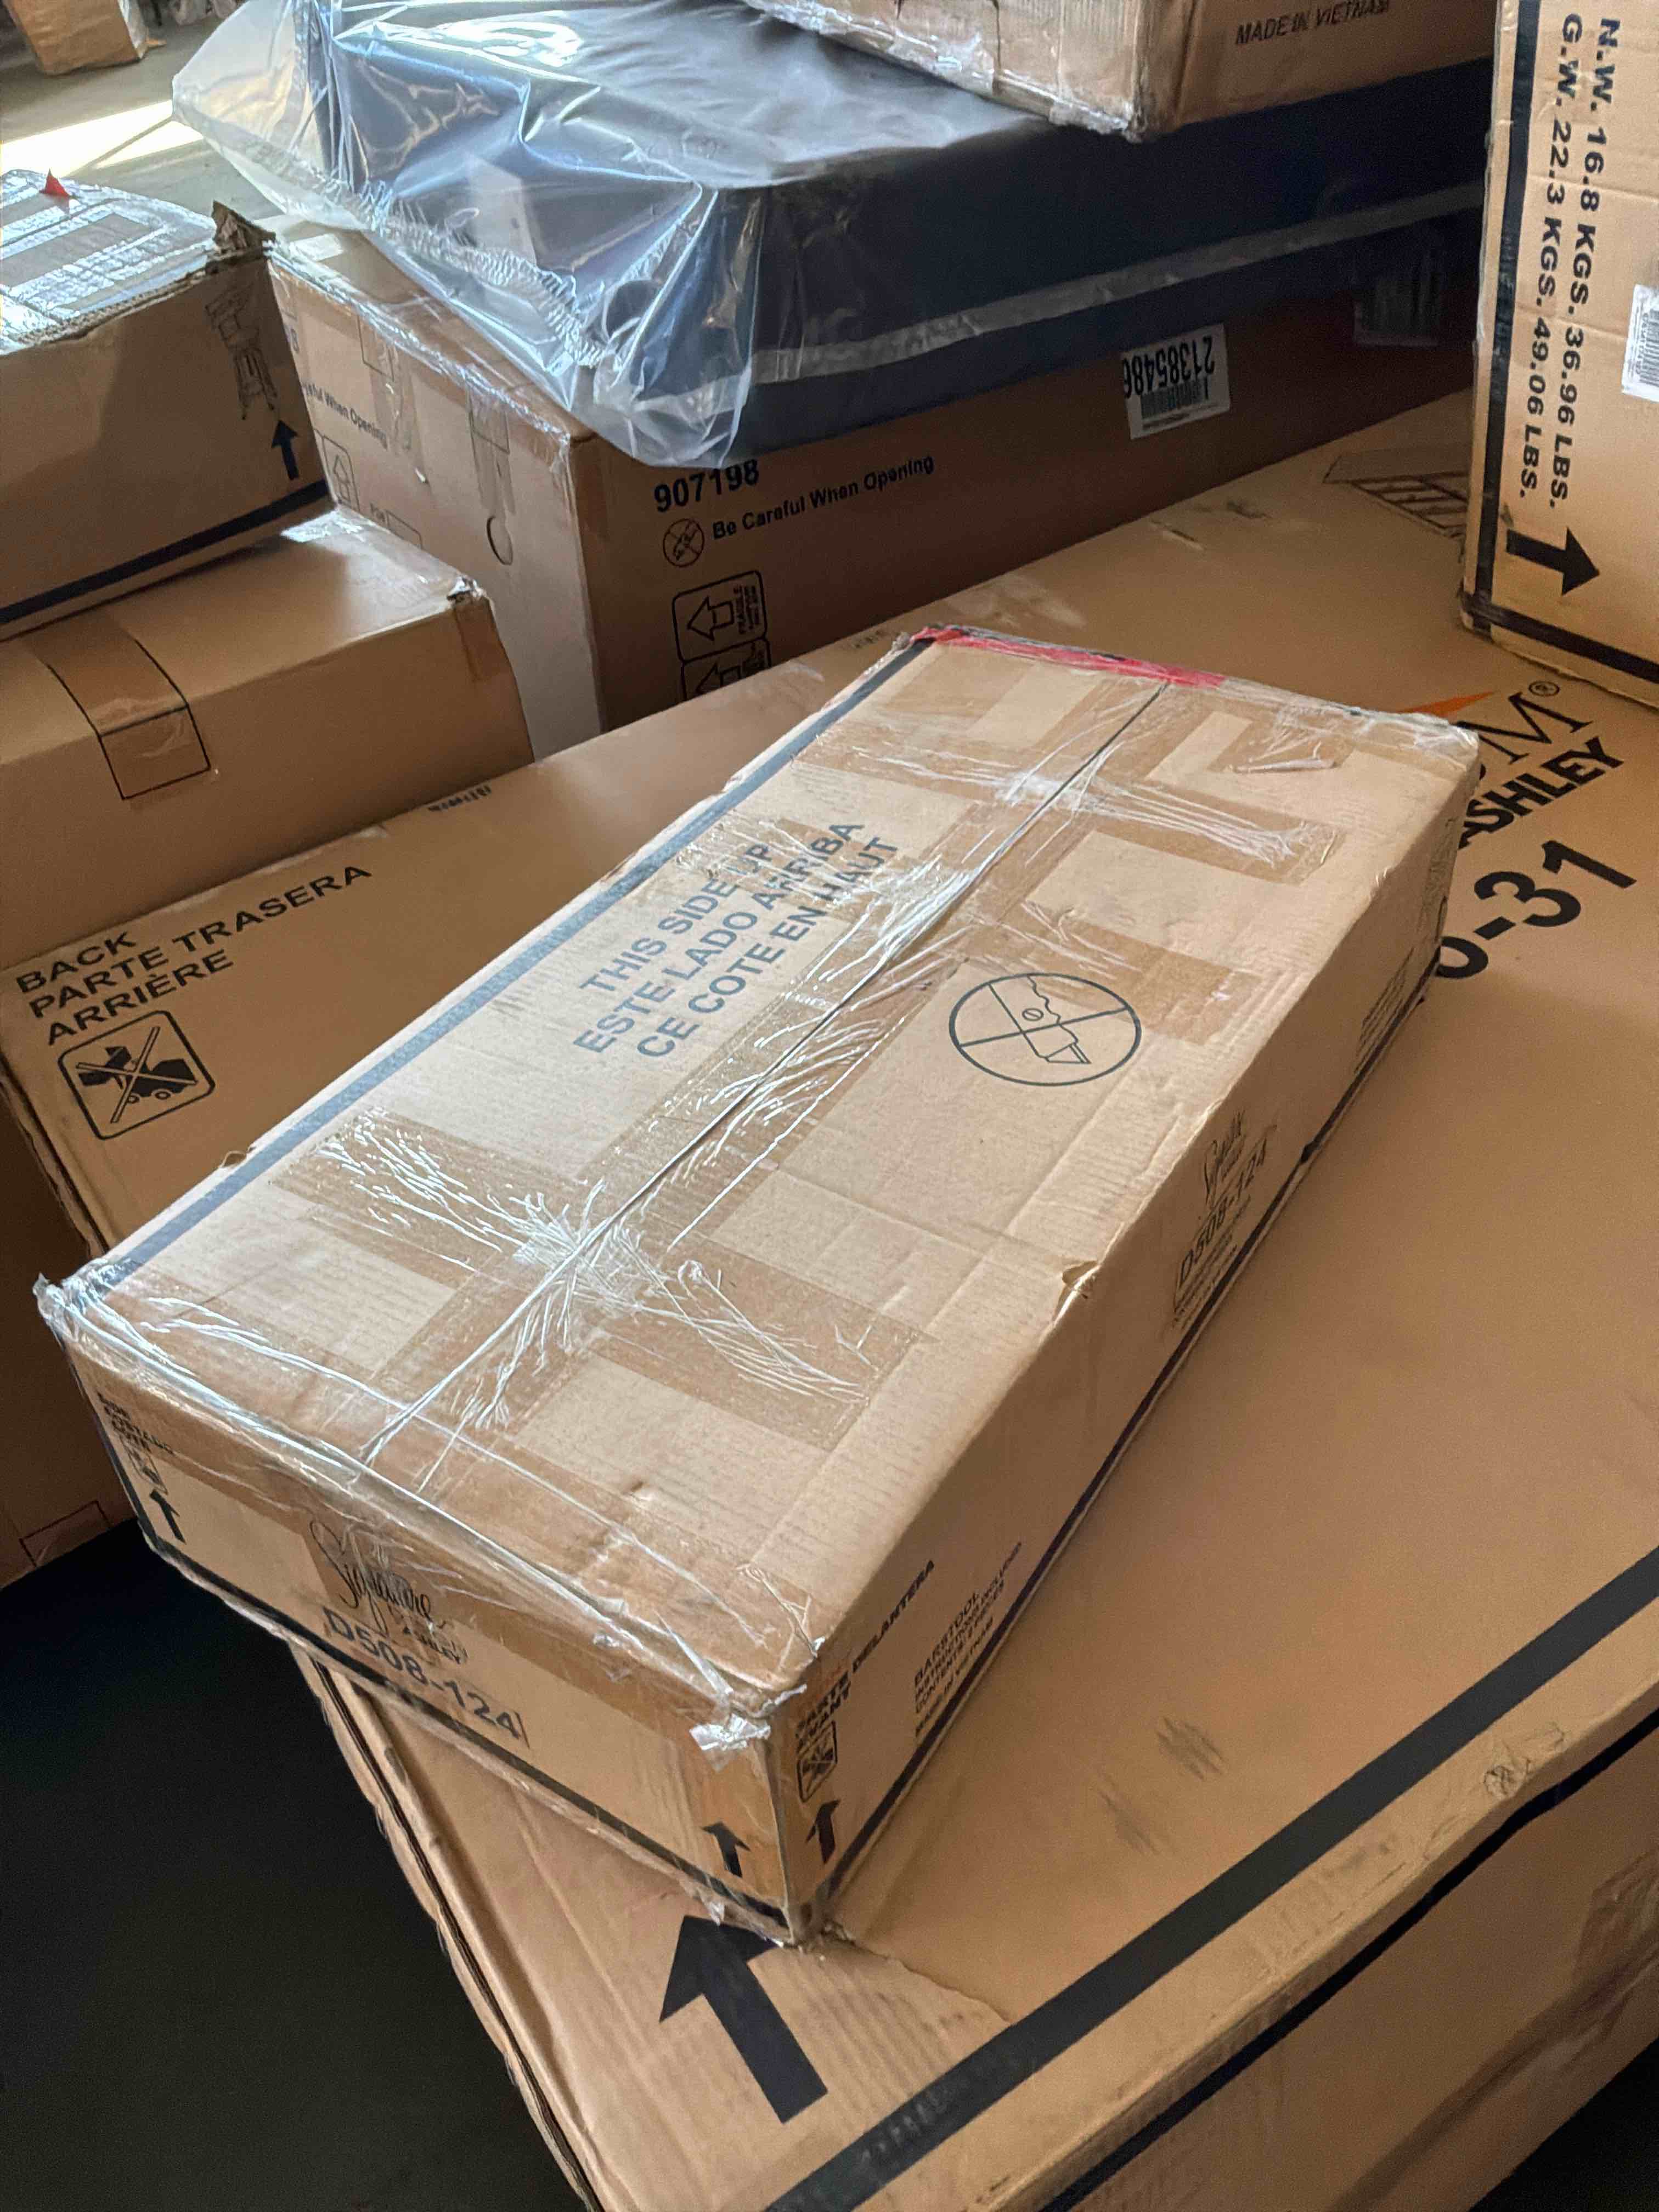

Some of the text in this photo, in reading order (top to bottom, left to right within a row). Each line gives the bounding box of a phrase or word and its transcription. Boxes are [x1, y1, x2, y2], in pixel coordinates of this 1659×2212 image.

[1237, 15, 1289, 44] MADE
[1291, 10, 1310, 32] IN
[1520, 13, 1583, 498] G.W. 22.3 KGS. 49.06 LBS.
[1549, 18, 1620, 509] N.W. 16.8 KGS. 36.96 LBS.
[654, 459, 760, 512] 907198
[713, 454, 934, 540] Be Careful When Opening
[16, 932, 136, 994] BACK
[29, 865, 373, 1018] PARTE TRASERA
[573, 825, 865, 1053] ESTE LADO ARRIBA
[579, 844, 772, 992] THIS SIDE UP
[636, 837, 898, 1058] CE COTE EN HAUT
[48, 949, 234, 1046] ARRIÈRE
[321, 1606, 522, 1740] D508-124
